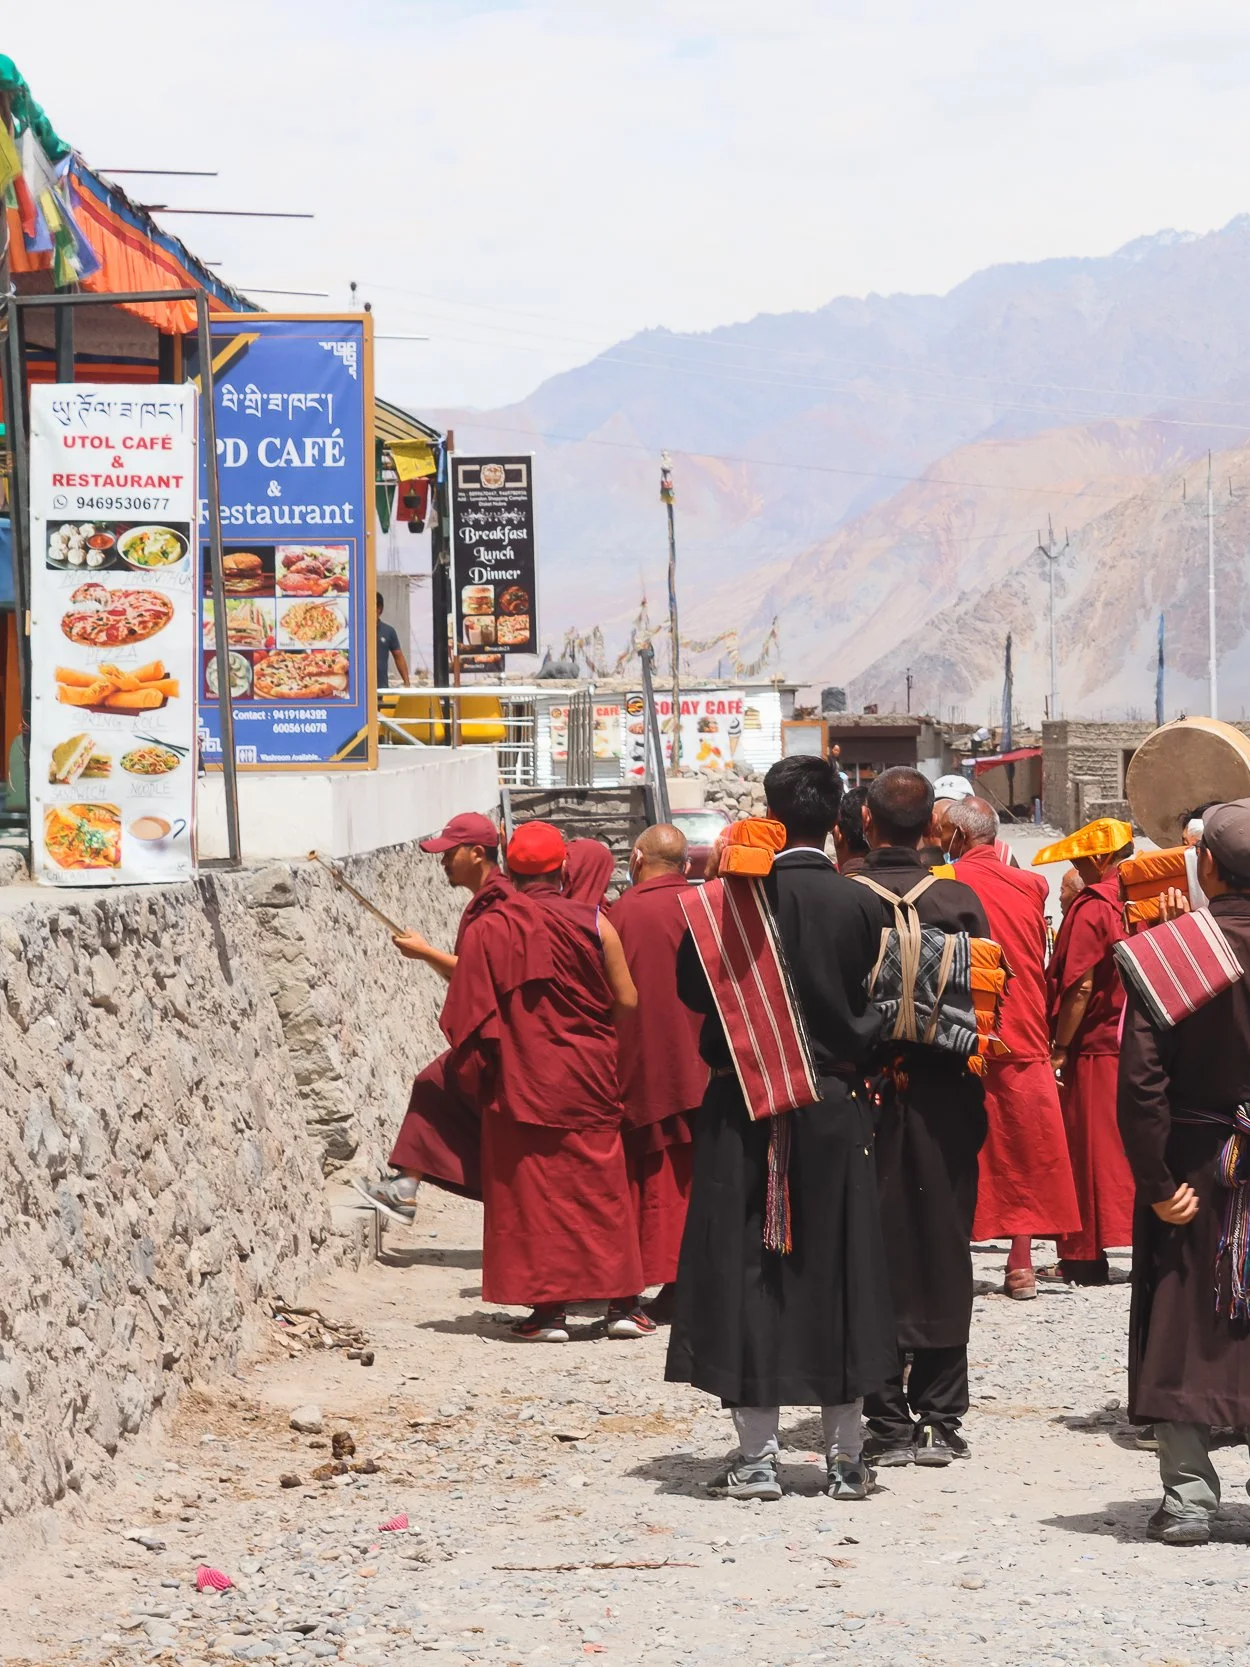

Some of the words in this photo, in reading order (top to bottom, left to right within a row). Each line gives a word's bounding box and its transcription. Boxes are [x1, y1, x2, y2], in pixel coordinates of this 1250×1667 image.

[63, 435, 116, 450] UTOL
[122, 434, 173, 451] CAFÉ
[257, 427, 346, 467] CAFÉ
[111, 455, 124, 468] &
[52, 473, 184, 489] RESTAURANT
[266, 480, 282, 497] &
[76, 496, 170, 510] 9469530677
[198, 498, 354, 525] Restaurant
[459, 526, 528, 545] Breakfast
[473, 546, 515, 565] Lunch
[468, 567, 521, 584] Dinner
[705, 698, 743, 714] CAFÉ
[232, 710, 266, 720] Contact
